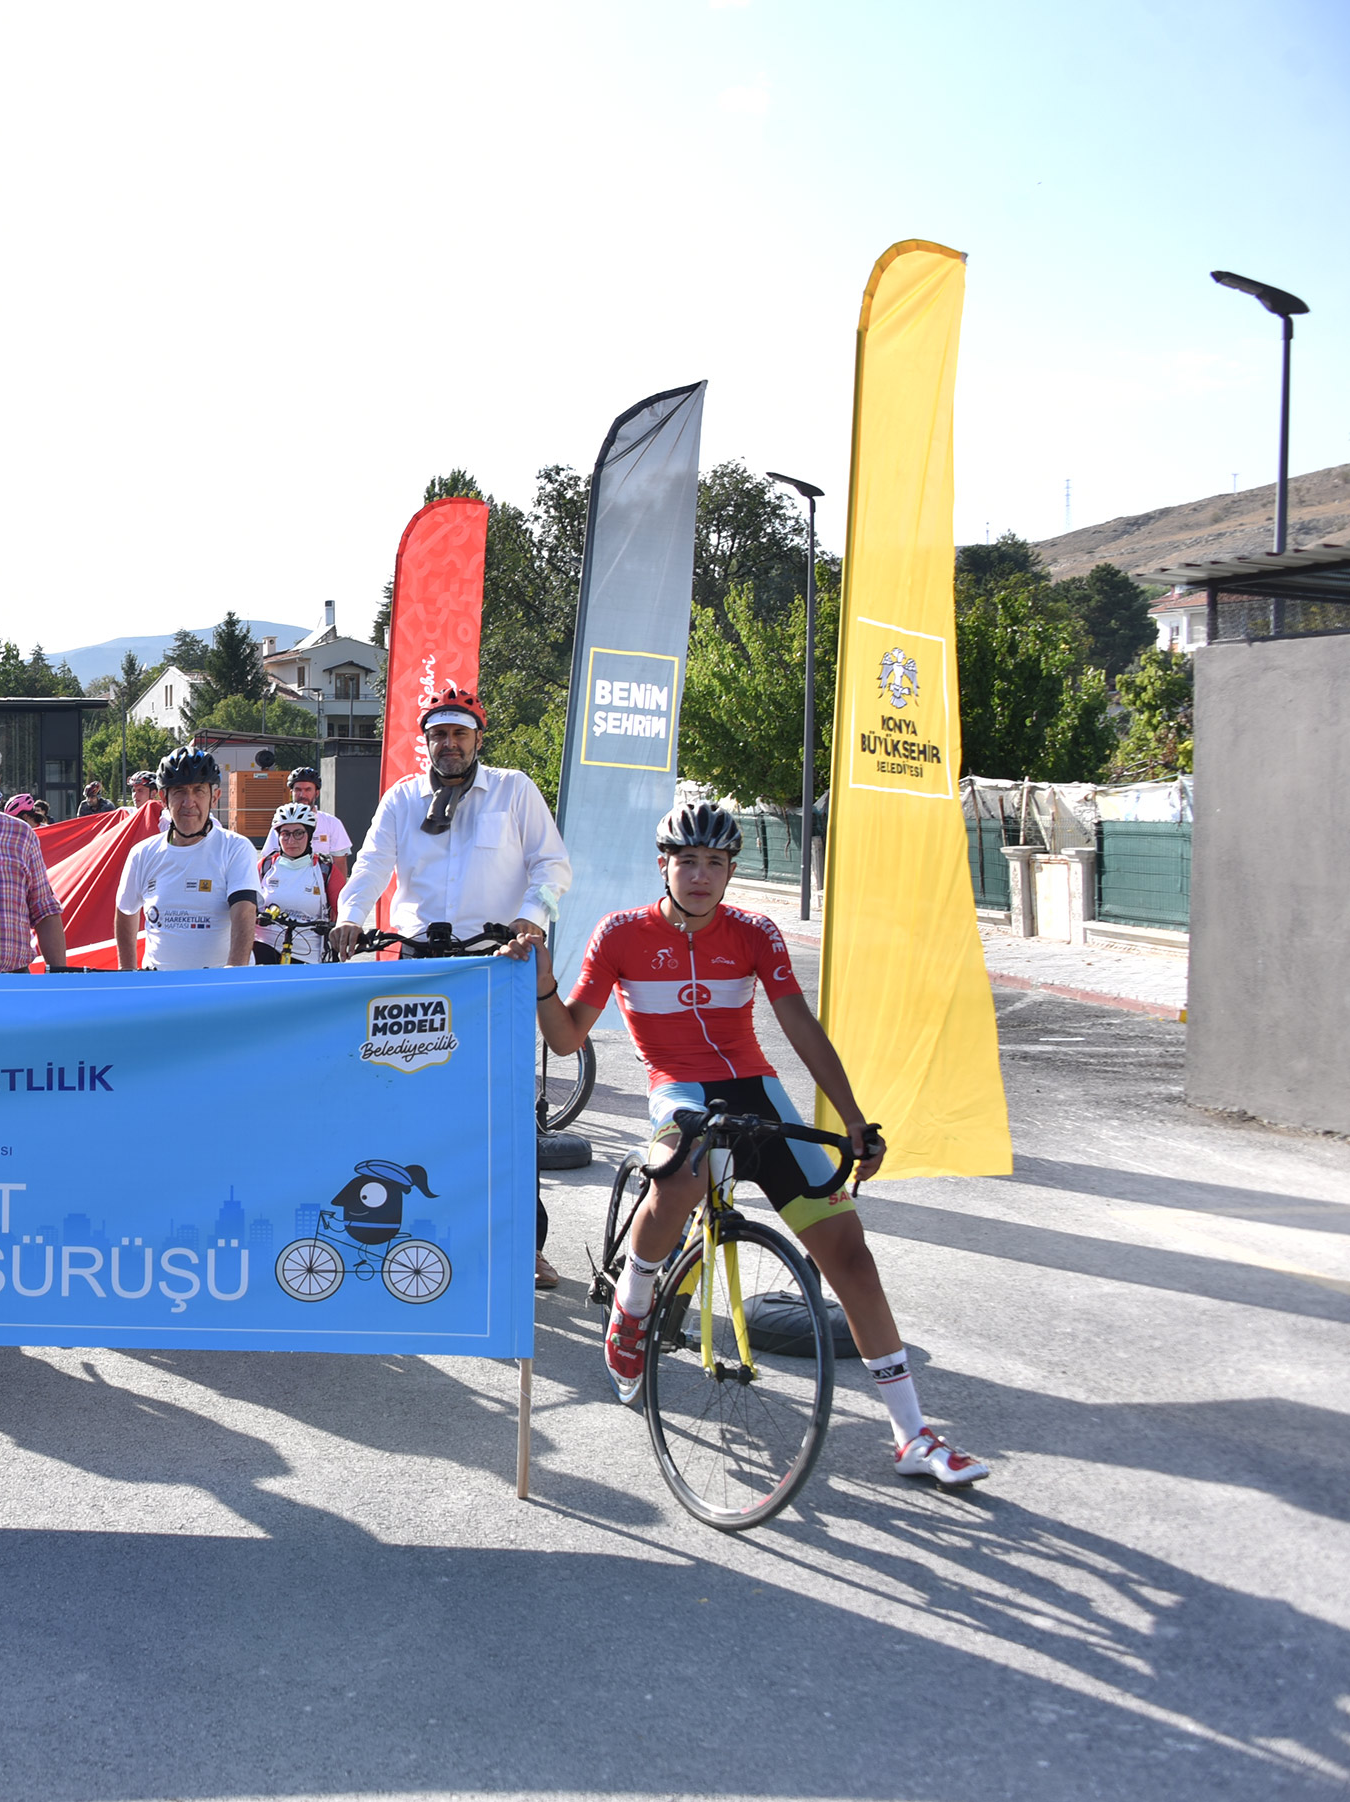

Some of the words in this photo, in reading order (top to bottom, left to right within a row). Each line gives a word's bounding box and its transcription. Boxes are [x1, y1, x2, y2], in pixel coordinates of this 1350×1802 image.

[881, 715, 918, 736] KONYA
[373, 1001, 446, 1020] KONYA
[371, 1017, 446, 1036] MODELİ
[360, 1034, 457, 1062] Belediyecilik
